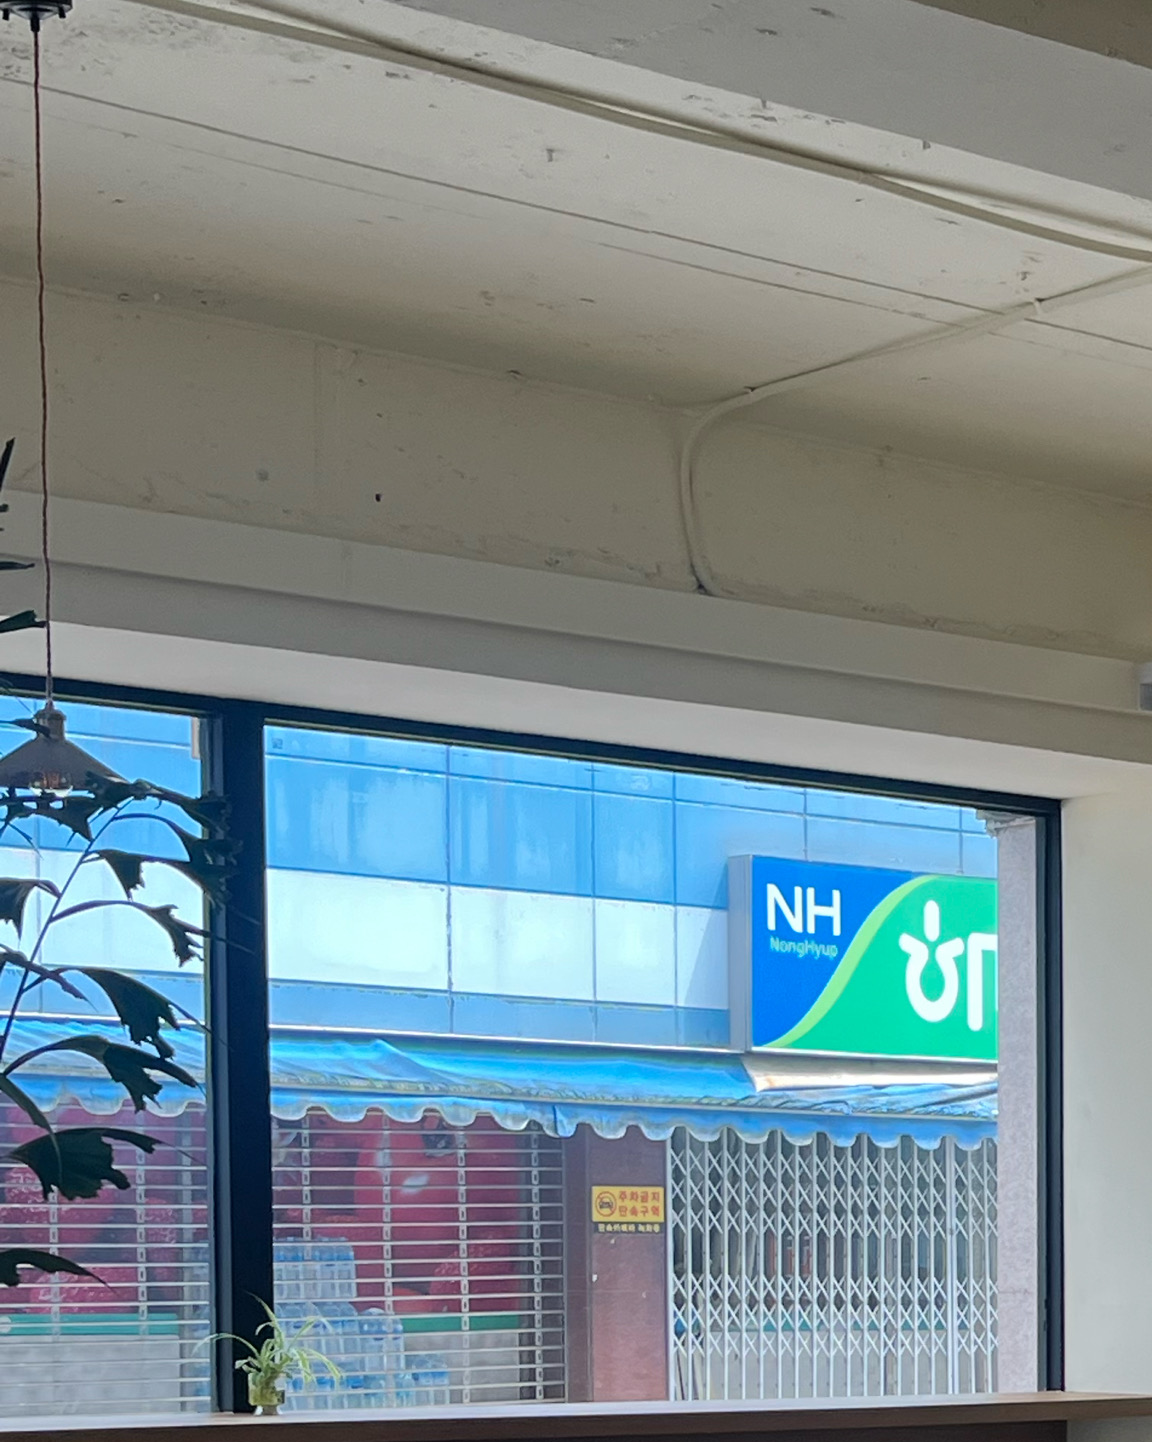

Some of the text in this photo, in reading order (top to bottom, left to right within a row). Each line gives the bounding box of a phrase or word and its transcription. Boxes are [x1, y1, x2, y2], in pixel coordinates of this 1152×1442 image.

[766, 883, 841, 936] NH
[770, 936, 838, 960] NongHyup
[619, 1191, 660, 1203] 주차금지
